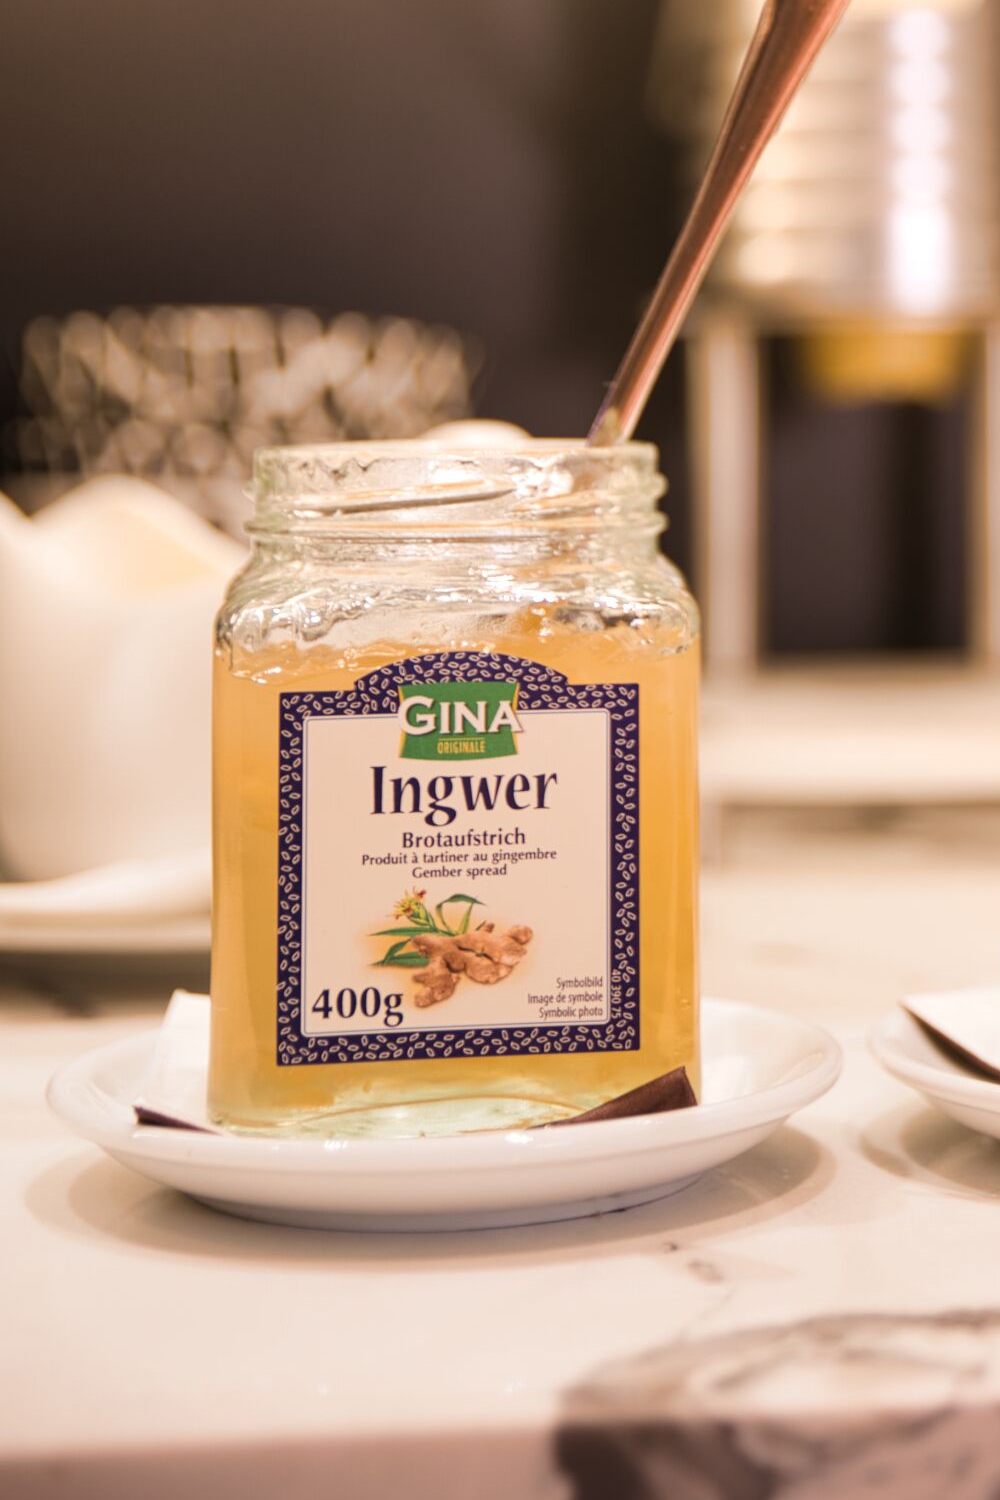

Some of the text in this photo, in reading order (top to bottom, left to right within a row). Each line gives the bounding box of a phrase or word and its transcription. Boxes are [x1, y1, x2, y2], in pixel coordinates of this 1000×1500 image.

[398, 695, 523, 736] GINA
[437, 739, 486, 755] ORIGINALE
[369, 765, 557, 827] Ingwer
[401, 827, 527, 849] Brotaufstrich
[361, 848, 557, 866] Produit à tartiner au gingembre
[412, 864, 507, 880] Gember spread
[556, 975, 603, 990] Symbolbild
[312, 986, 404, 1028] 400g
[528, 991, 603, 1006] Image de symbole
[539, 1005, 603, 1020] Symbolic photo
